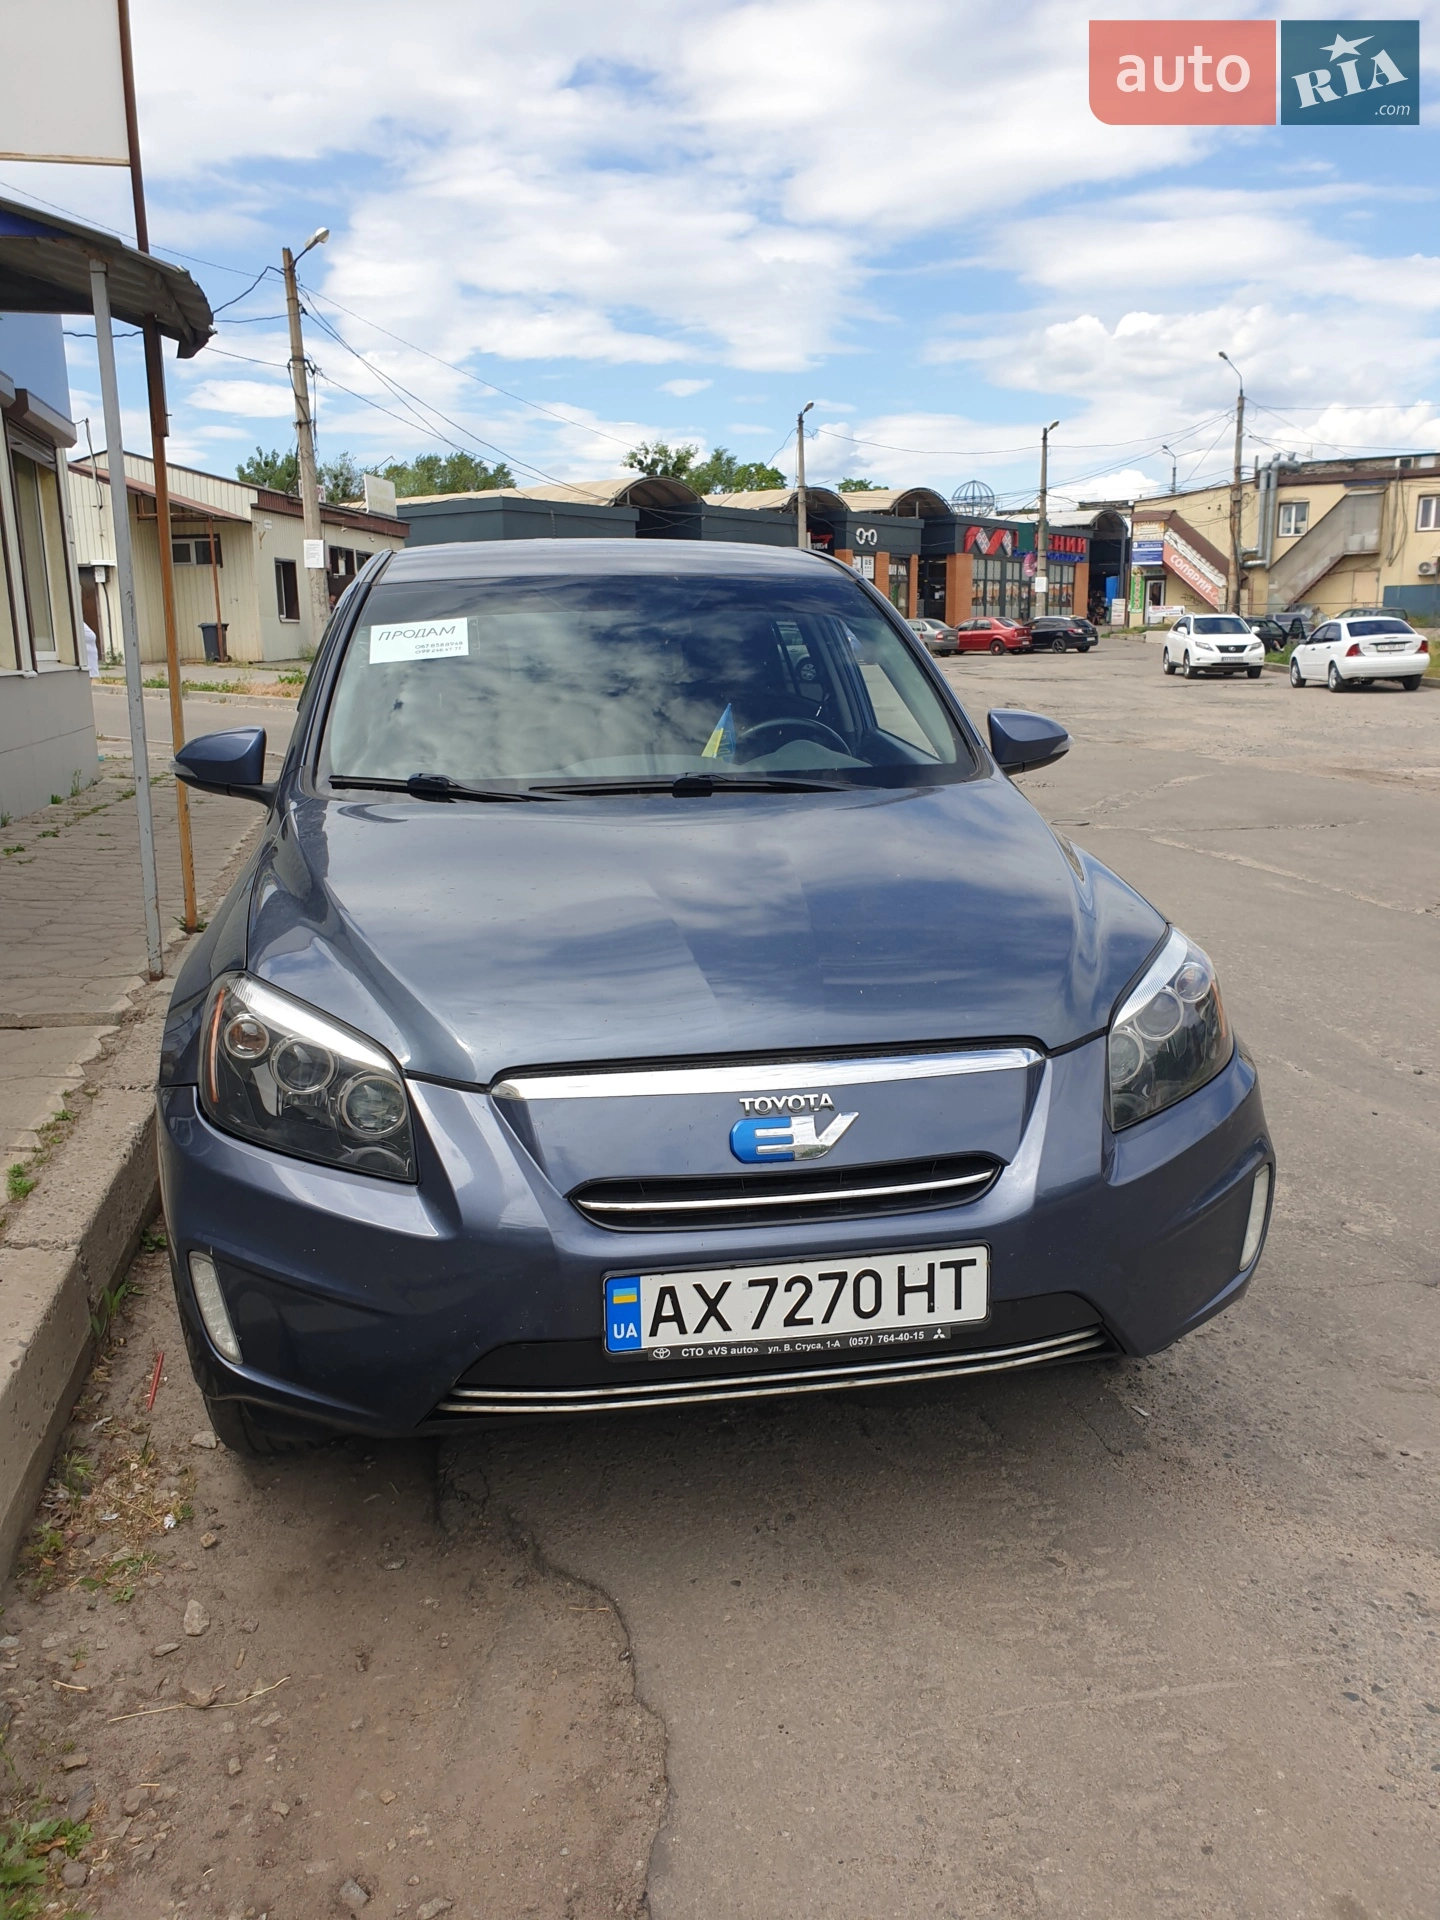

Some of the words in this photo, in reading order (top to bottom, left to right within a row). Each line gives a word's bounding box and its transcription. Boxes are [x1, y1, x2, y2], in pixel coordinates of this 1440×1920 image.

[378, 625, 456, 641] ПРОДАМ
[739, 1093, 835, 1116] TOYOTA
[729, 1111, 860, 1164] EV
[648, 1280, 732, 1338] AX
[748, 1268, 883, 1330] 7270
[897, 1258, 977, 1317] HT
[613, 1322, 638, 1339] UA
[681, 1348, 704, 1357] СТО
[768, 1345, 782, 1354] ул.
[784, 1344, 793, 1352] В.
[795, 1342, 824, 1352] Стуса,
[826, 1340, 841, 1349] 1-А
[849, 1335, 873, 1347] (057)
[877, 1331, 925, 1344] 764-40-15
